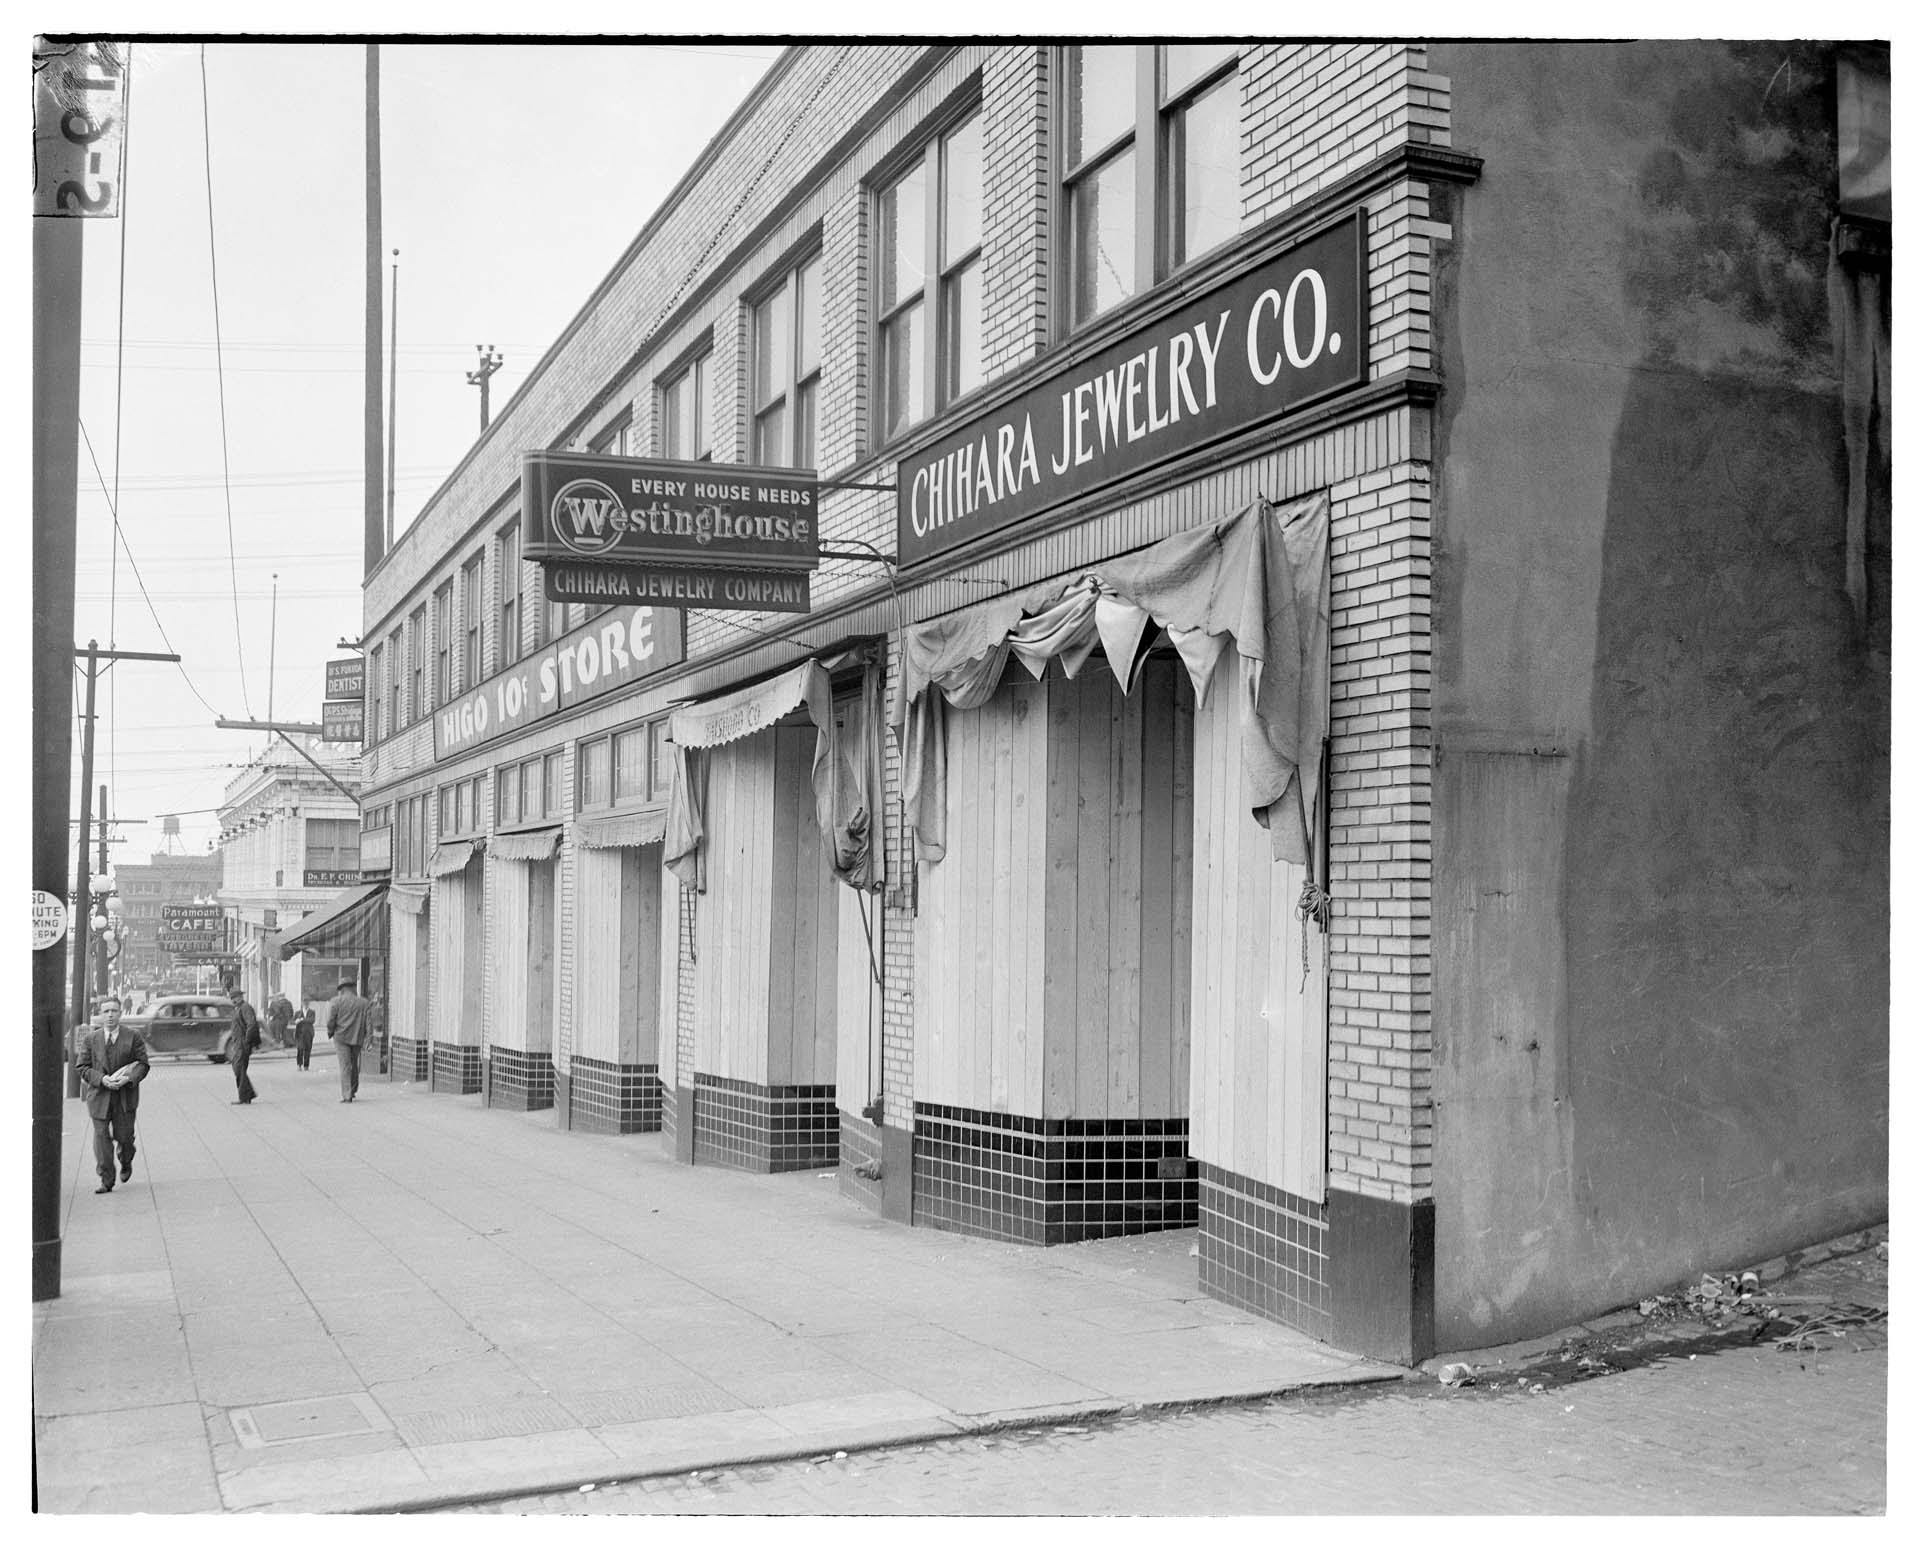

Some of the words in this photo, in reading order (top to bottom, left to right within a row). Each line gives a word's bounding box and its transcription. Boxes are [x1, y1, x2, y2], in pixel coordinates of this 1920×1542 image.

[911, 411, 1041, 538] CHIHARA
[1051, 309, 1231, 476] JEWELRY
[1247, 268, 1342, 386] CO.
[631, 478, 687, 497] EVERY
[694, 483, 750, 501] HOUSE
[757, 488, 811, 506] NEEDS
[562, 496, 811, 546] Westinghouse
[553, 569, 630, 597] CHIHARA
[636, 572, 715, 601] JEWELRY
[724, 577, 804, 604] COMPANY
[328, 676, 363, 693] DENTIST
[442, 695, 488, 748] HIGO
[540, 605, 655, 704] STORE
[171, 919, 214, 930] CAFE
